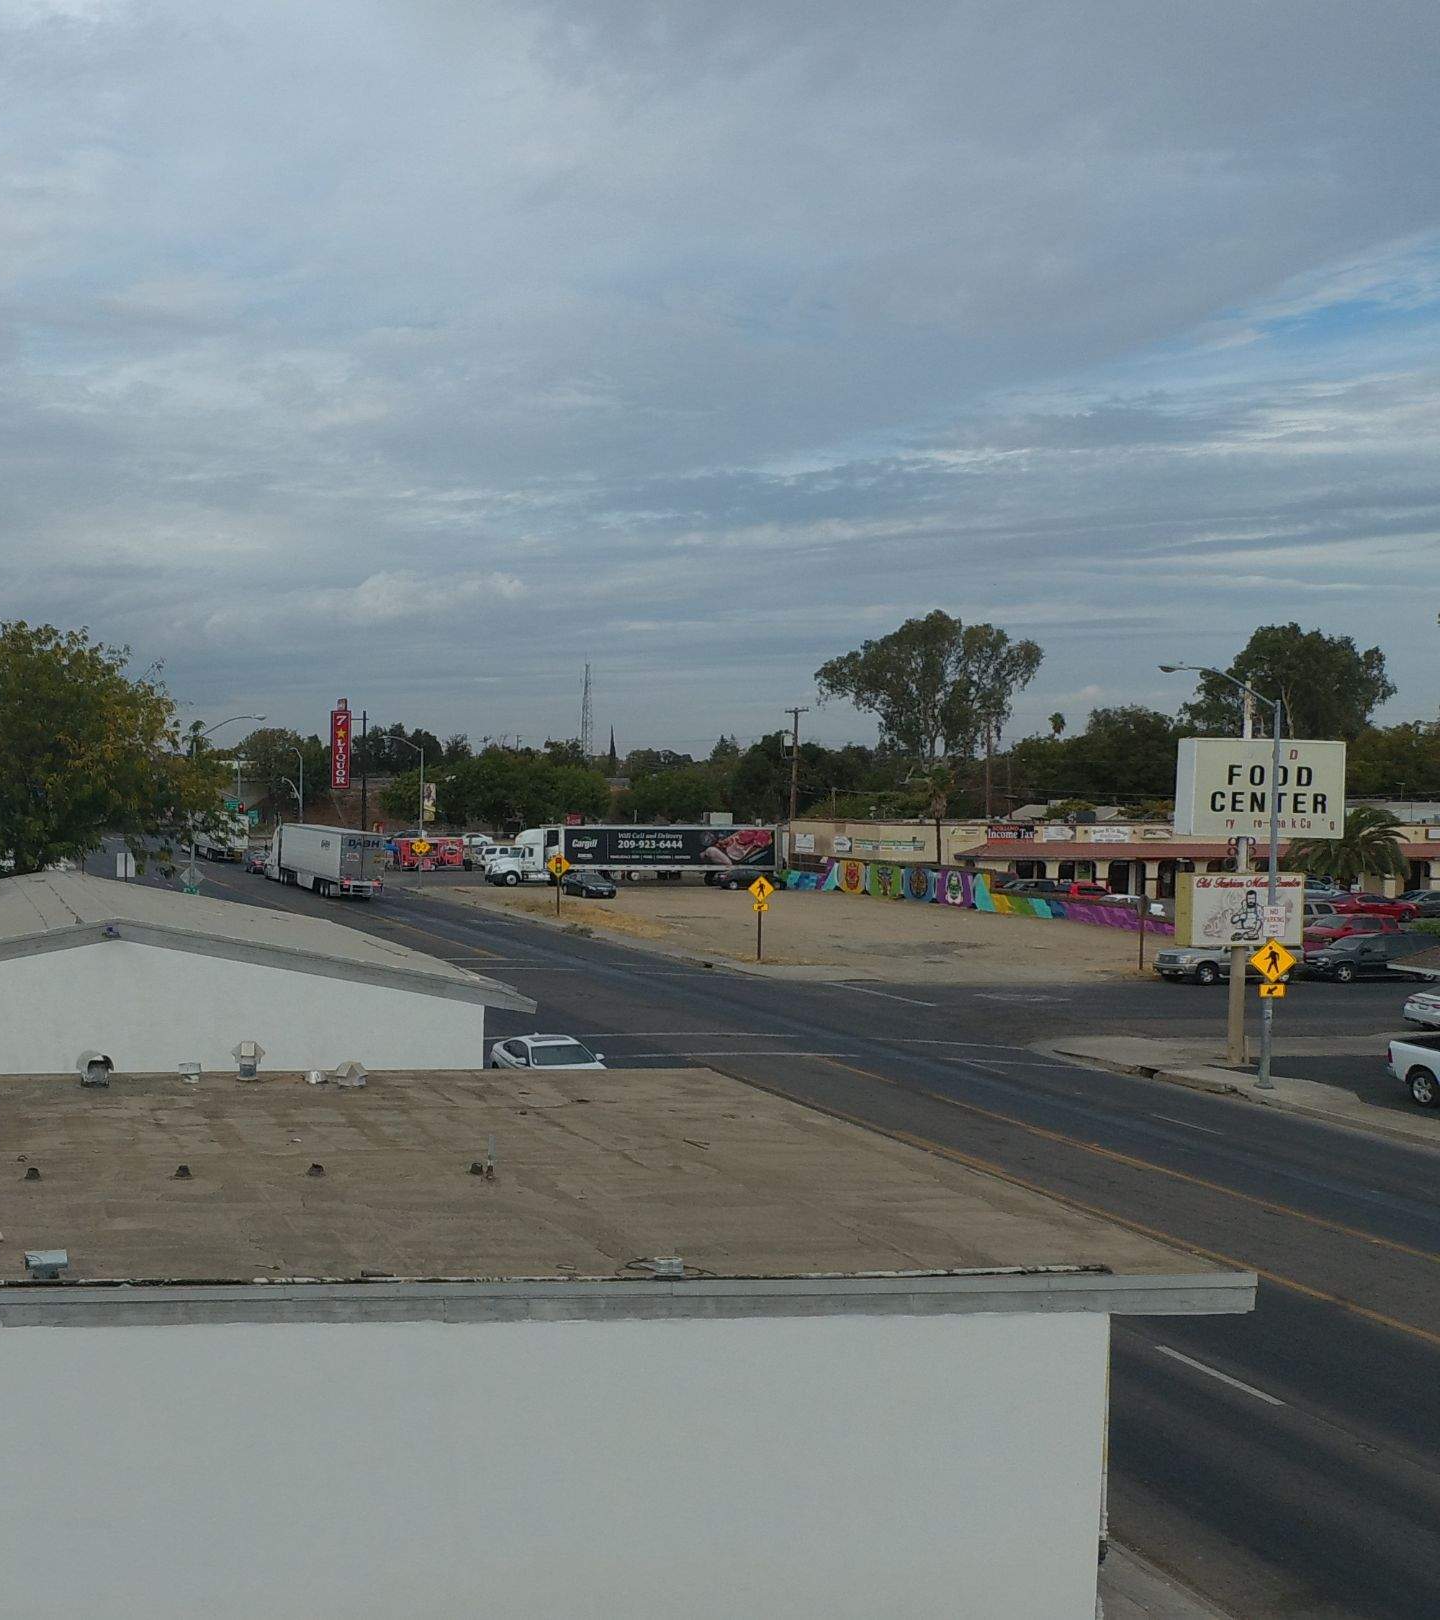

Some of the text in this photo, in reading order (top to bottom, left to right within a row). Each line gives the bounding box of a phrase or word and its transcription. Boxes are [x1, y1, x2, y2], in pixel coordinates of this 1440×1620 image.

[336, 715, 347, 725] 7
[336, 740, 346, 784] LIQUOR
[1227, 764, 1313, 787] FOOD
[1210, 791, 1327, 814] CENTER
[987, 829, 1019, 839] Income
[1020, 829, 1035, 839] Tax
[572, 838, 598, 850] Cargill
[617, 840, 683, 849] 209-923-6444
